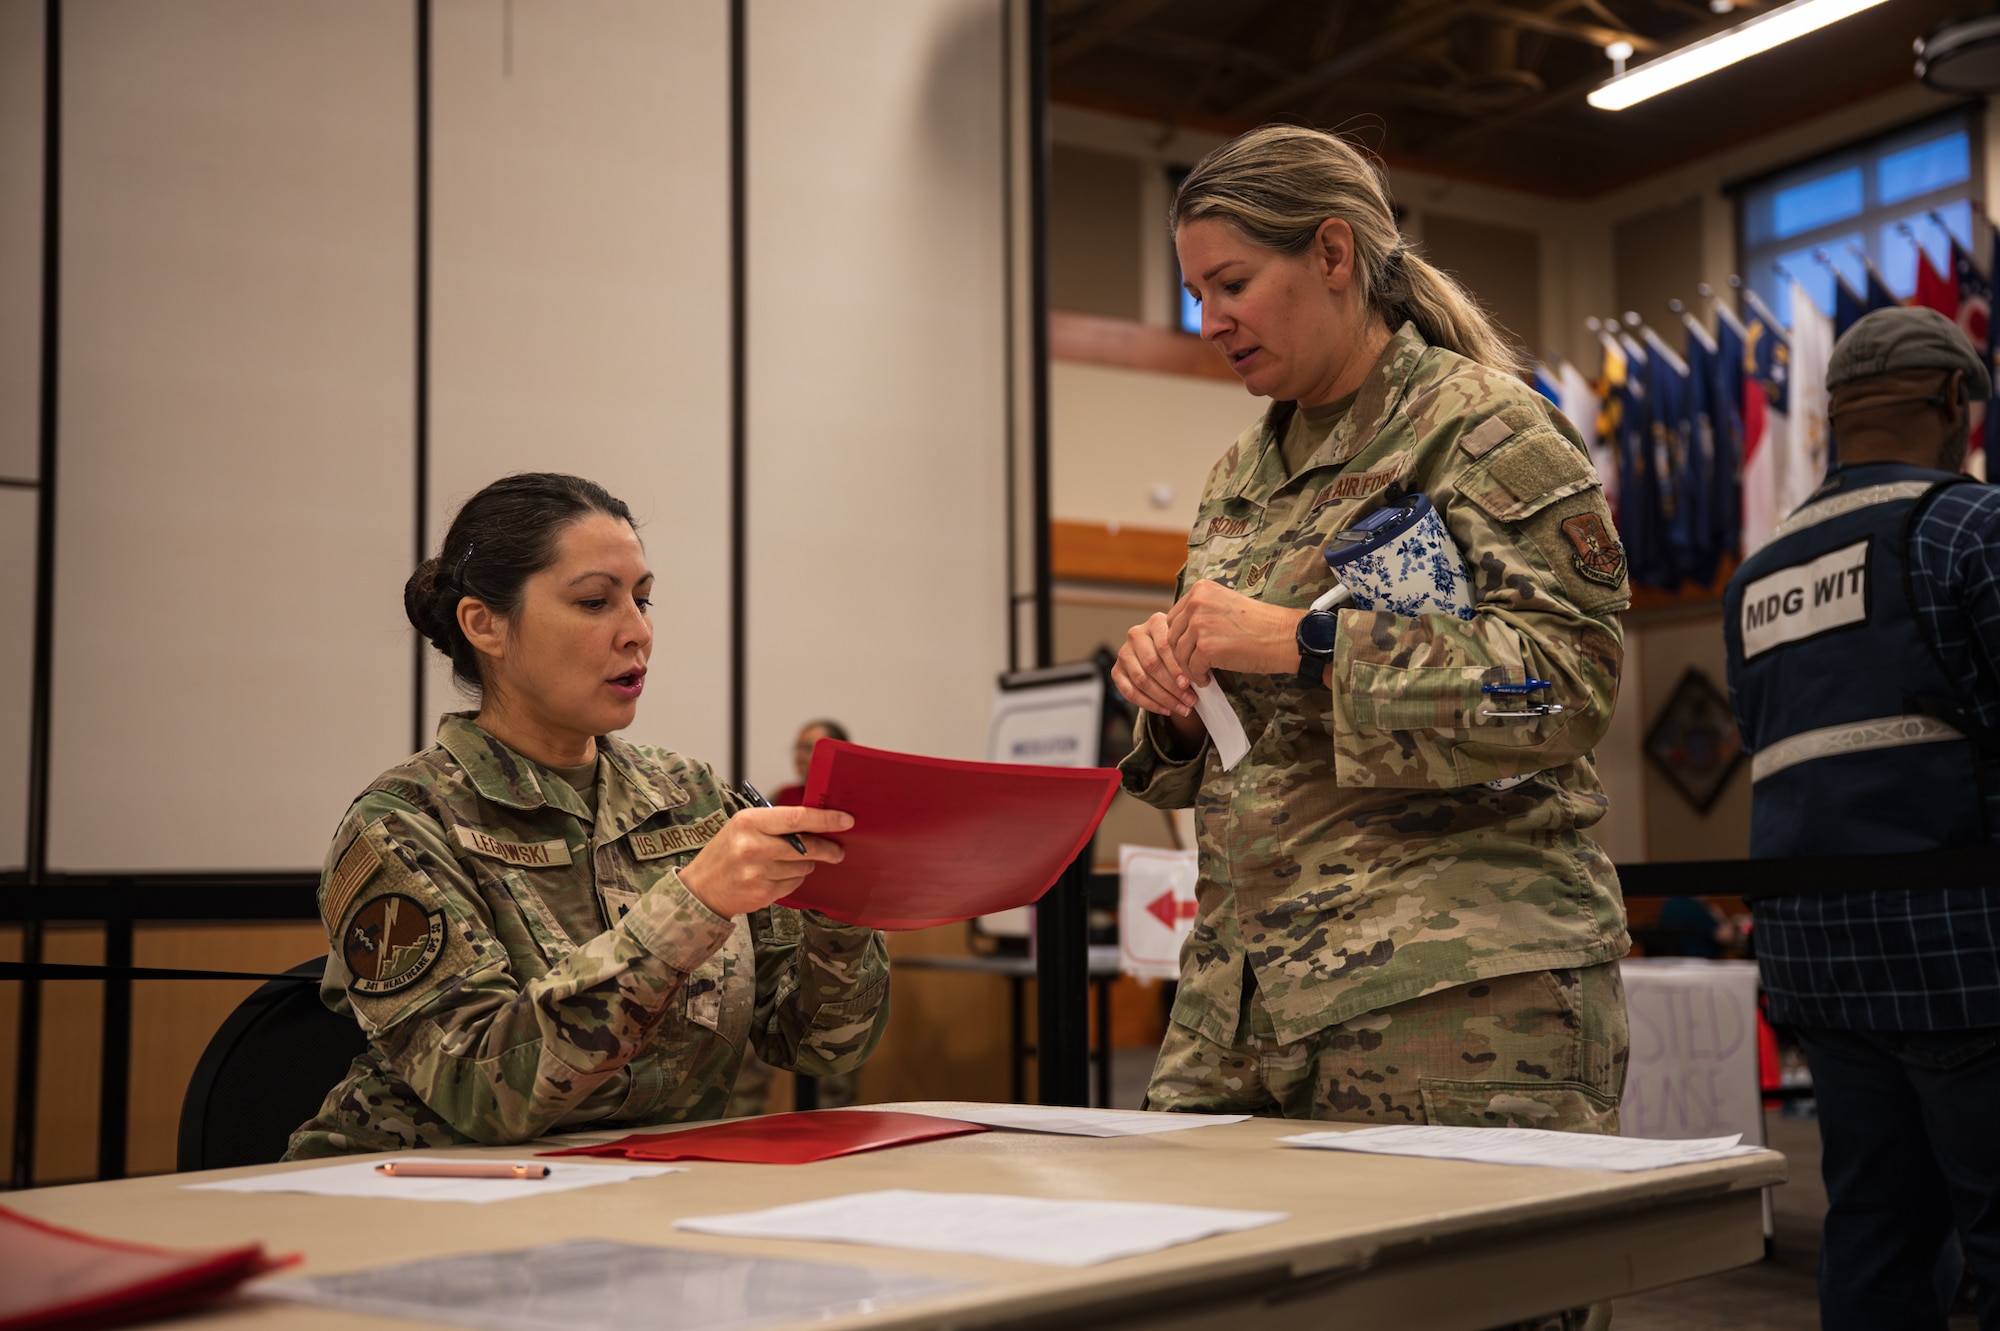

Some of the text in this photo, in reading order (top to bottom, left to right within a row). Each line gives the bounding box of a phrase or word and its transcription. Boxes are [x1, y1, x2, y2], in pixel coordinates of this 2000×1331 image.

[1332, 477, 1360, 498] AIR
[1746, 564, 1866, 632] MDG WIT
[471, 832, 550, 864] LEGOWSKI
[635, 813, 725, 856] U.S. AIR FORCE
[363, 981, 379, 991] 341
[383, 956, 430, 990] HEALTHCARE
[427, 938, 440, 953] OPS
